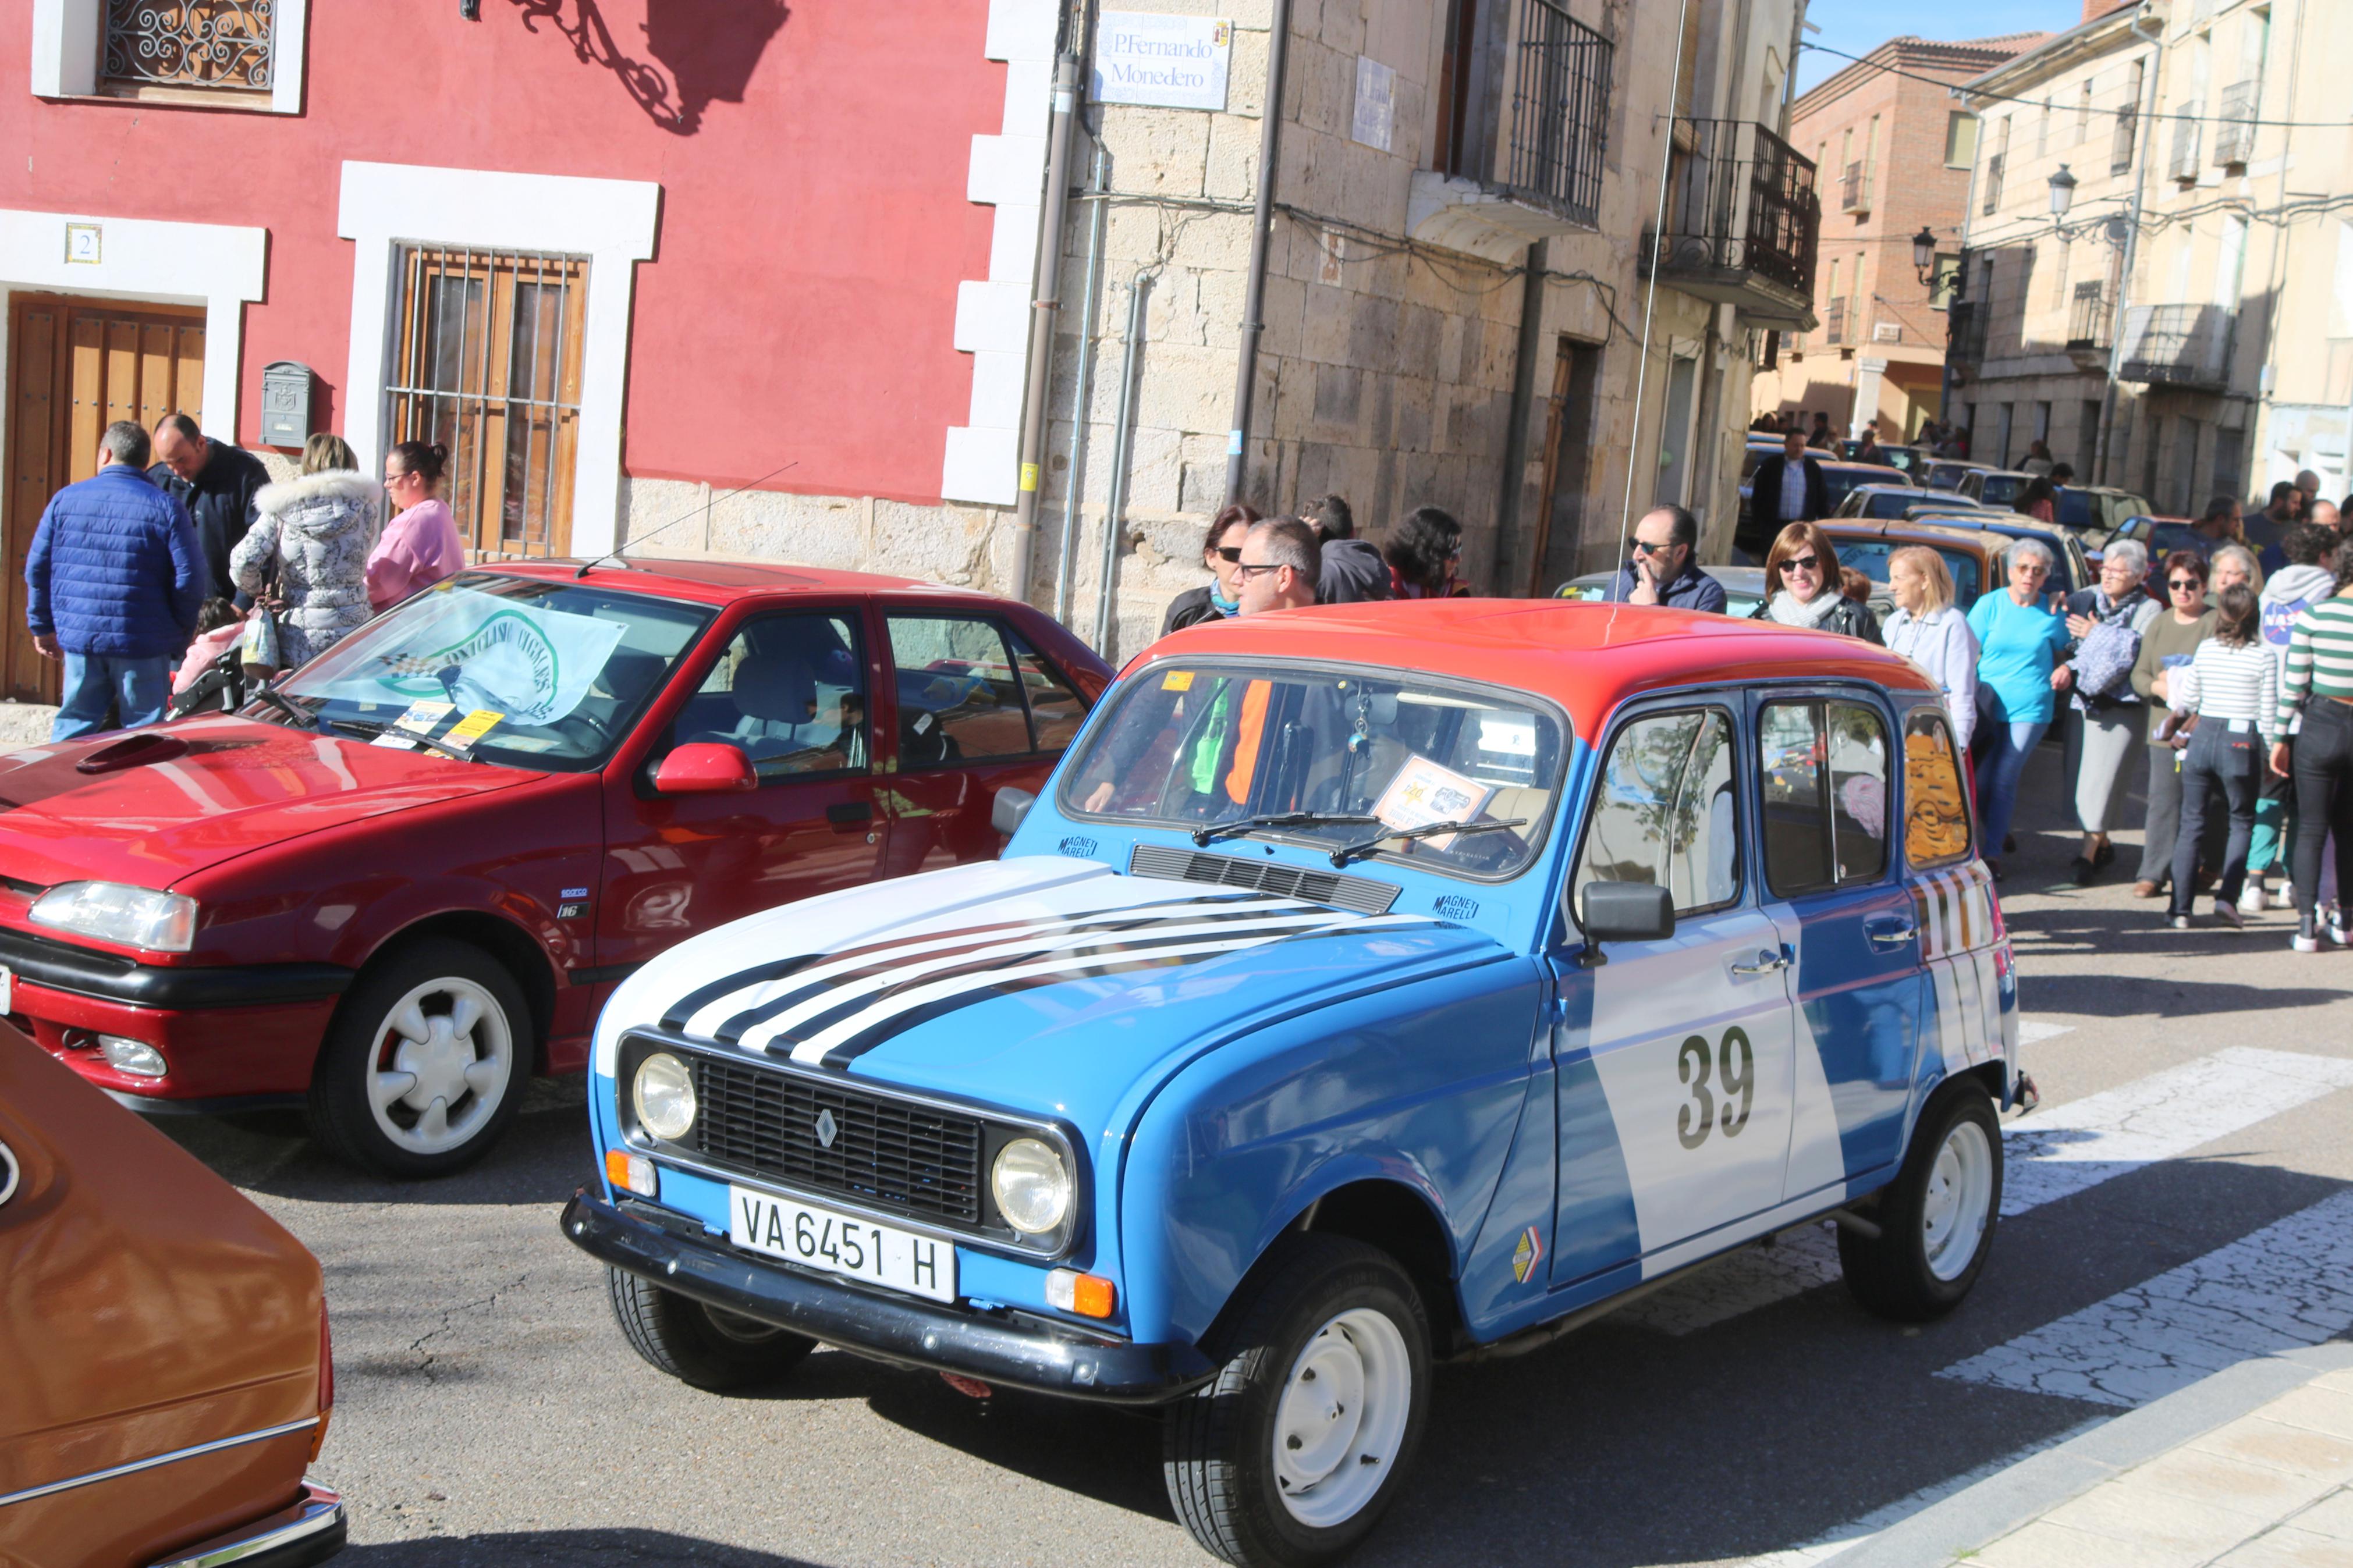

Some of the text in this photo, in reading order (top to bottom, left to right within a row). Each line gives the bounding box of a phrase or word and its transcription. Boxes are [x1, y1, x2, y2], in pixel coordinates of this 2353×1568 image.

[1114, 33, 1213, 59] P.Fernando
[1111, 63, 1204, 88] Monedero
[80, 234, 90, 254] 2
[1057, 835, 1098, 851] MAGNETI
[1057, 842, 1098, 858] MARELLI
[560, 887, 587, 898] sparco
[560, 905, 578, 918] 16
[1432, 895, 1479, 912] MAGNETI
[1432, 901, 1479, 920] MARELLI
[1677, 1025, 1755, 1150] 39
[913, 1239, 936, 1289] H
